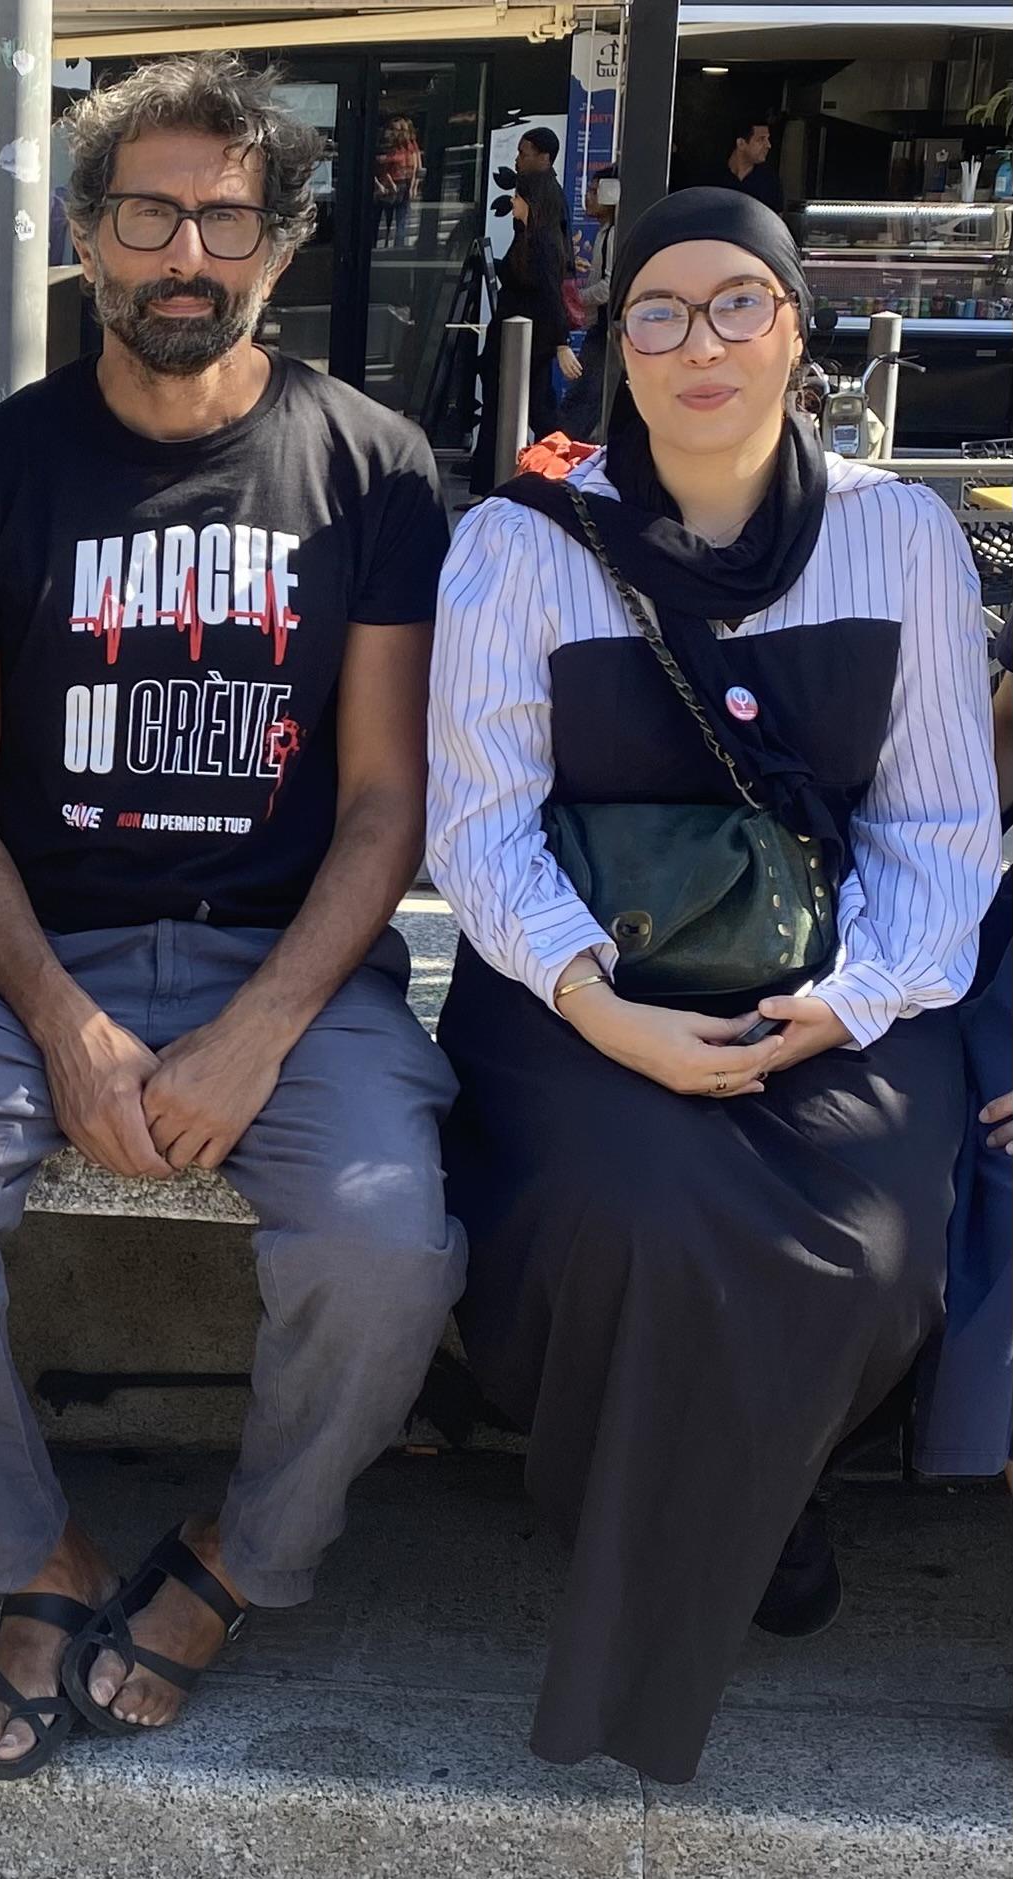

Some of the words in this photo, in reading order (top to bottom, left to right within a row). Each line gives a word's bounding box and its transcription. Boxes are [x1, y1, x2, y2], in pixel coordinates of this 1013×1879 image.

[71, 523, 300, 632] MARCHE
[64, 683, 119, 774] OU
[126, 671, 292, 778] CRÈVE
[61, 803, 104, 829] SAVE
[116, 812, 141, 828] NON
[141, 813, 159, 829] AU
[160, 814, 206, 832] PERMIS
[207, 816, 223, 832] DE
[223, 817, 252, 834] TUER
